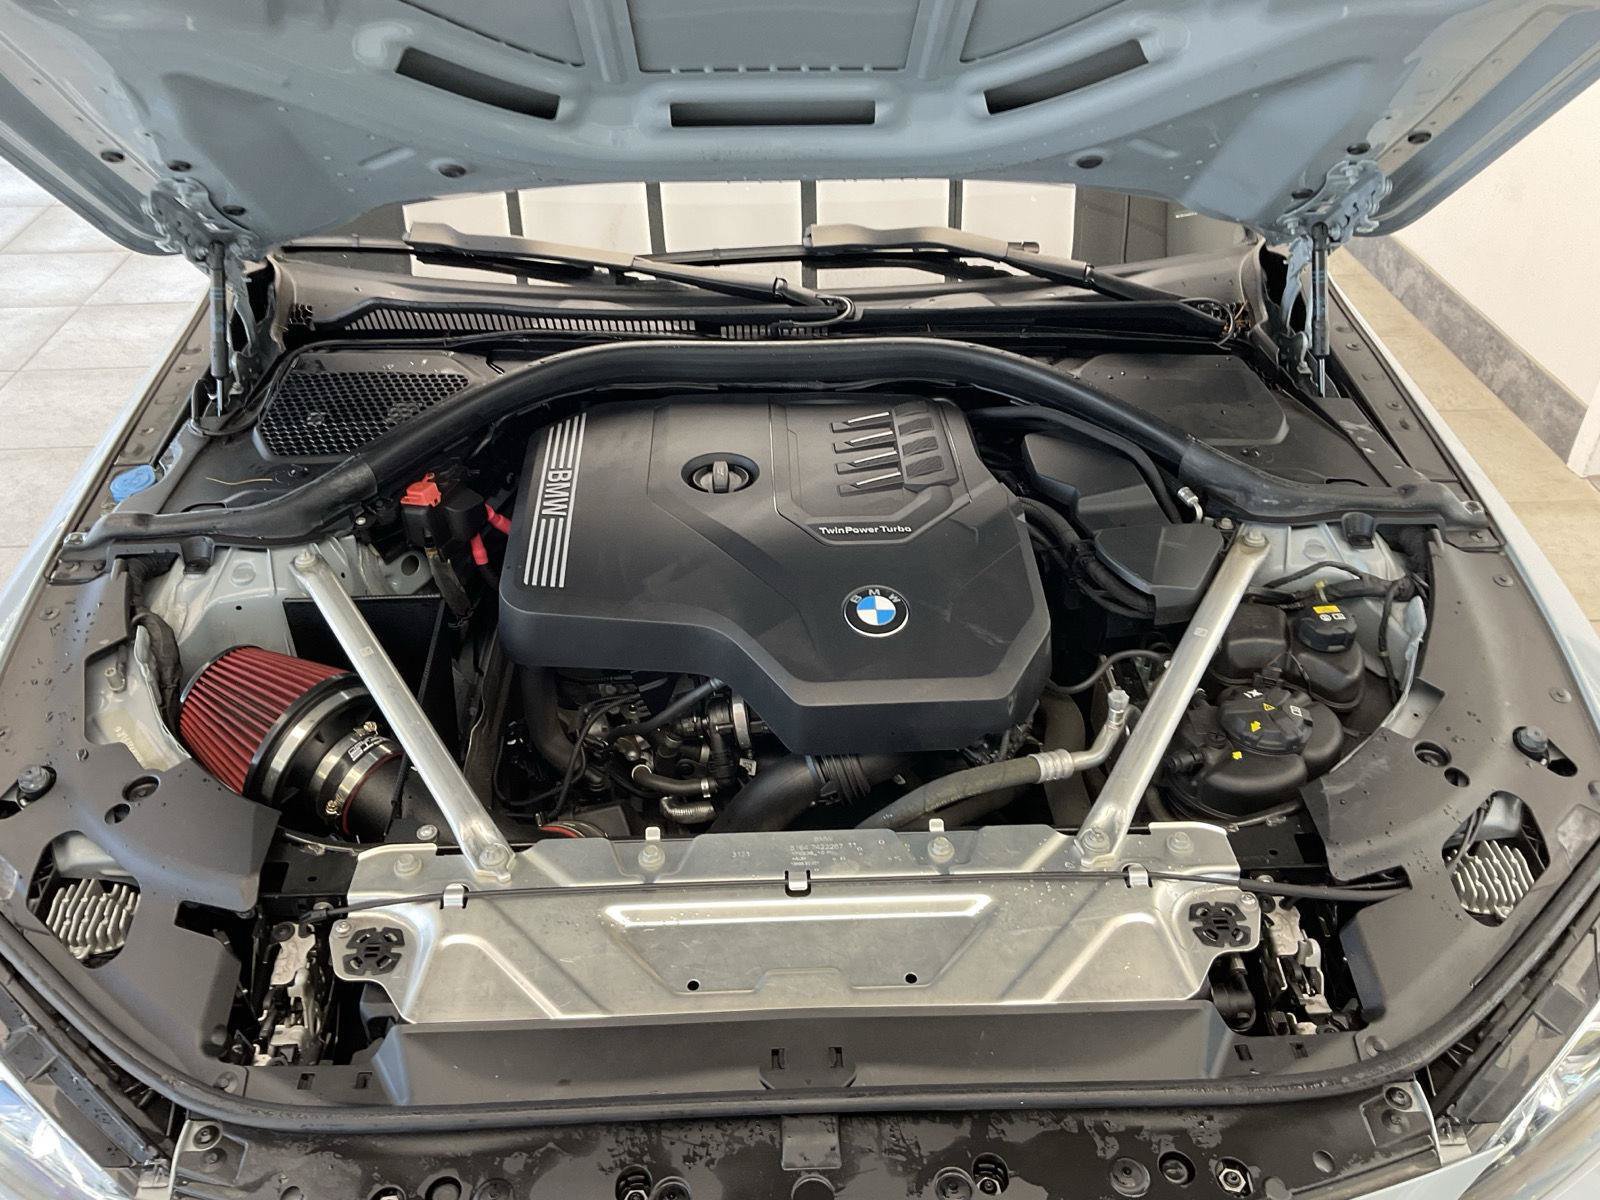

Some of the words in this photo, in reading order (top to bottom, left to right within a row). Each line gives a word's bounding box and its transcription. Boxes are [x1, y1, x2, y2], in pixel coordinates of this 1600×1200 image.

[541, 470, 572, 516] BMW
[879, 525, 912, 533] Turbo
[850, 589, 901, 604] BMW
